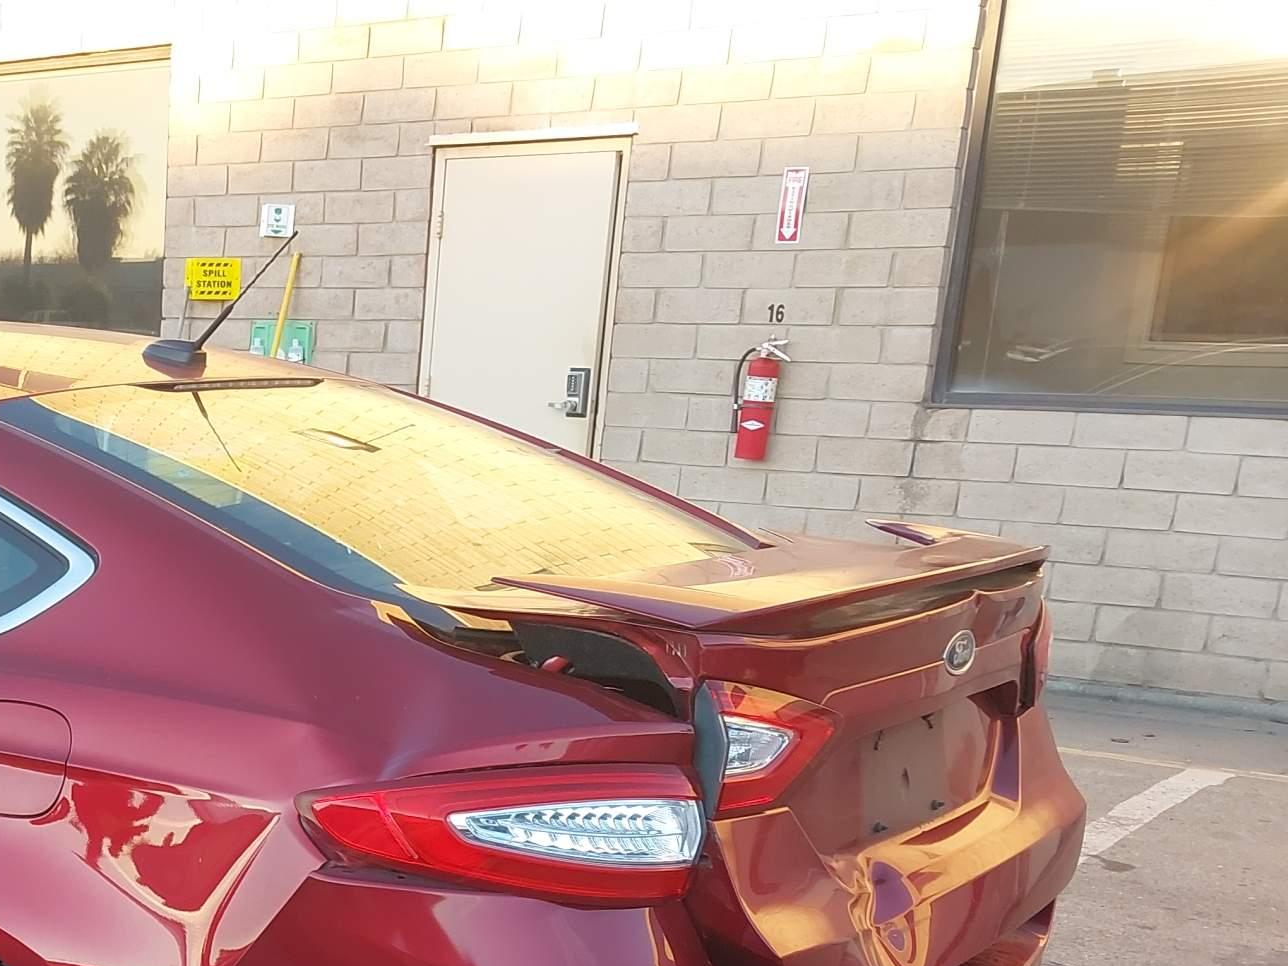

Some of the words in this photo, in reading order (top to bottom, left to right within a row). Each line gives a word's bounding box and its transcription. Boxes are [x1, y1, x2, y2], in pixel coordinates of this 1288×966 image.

[202, 269, 227, 277] SPILL
[196, 280, 233, 288] STATION
[768, 303, 785, 323] 16
